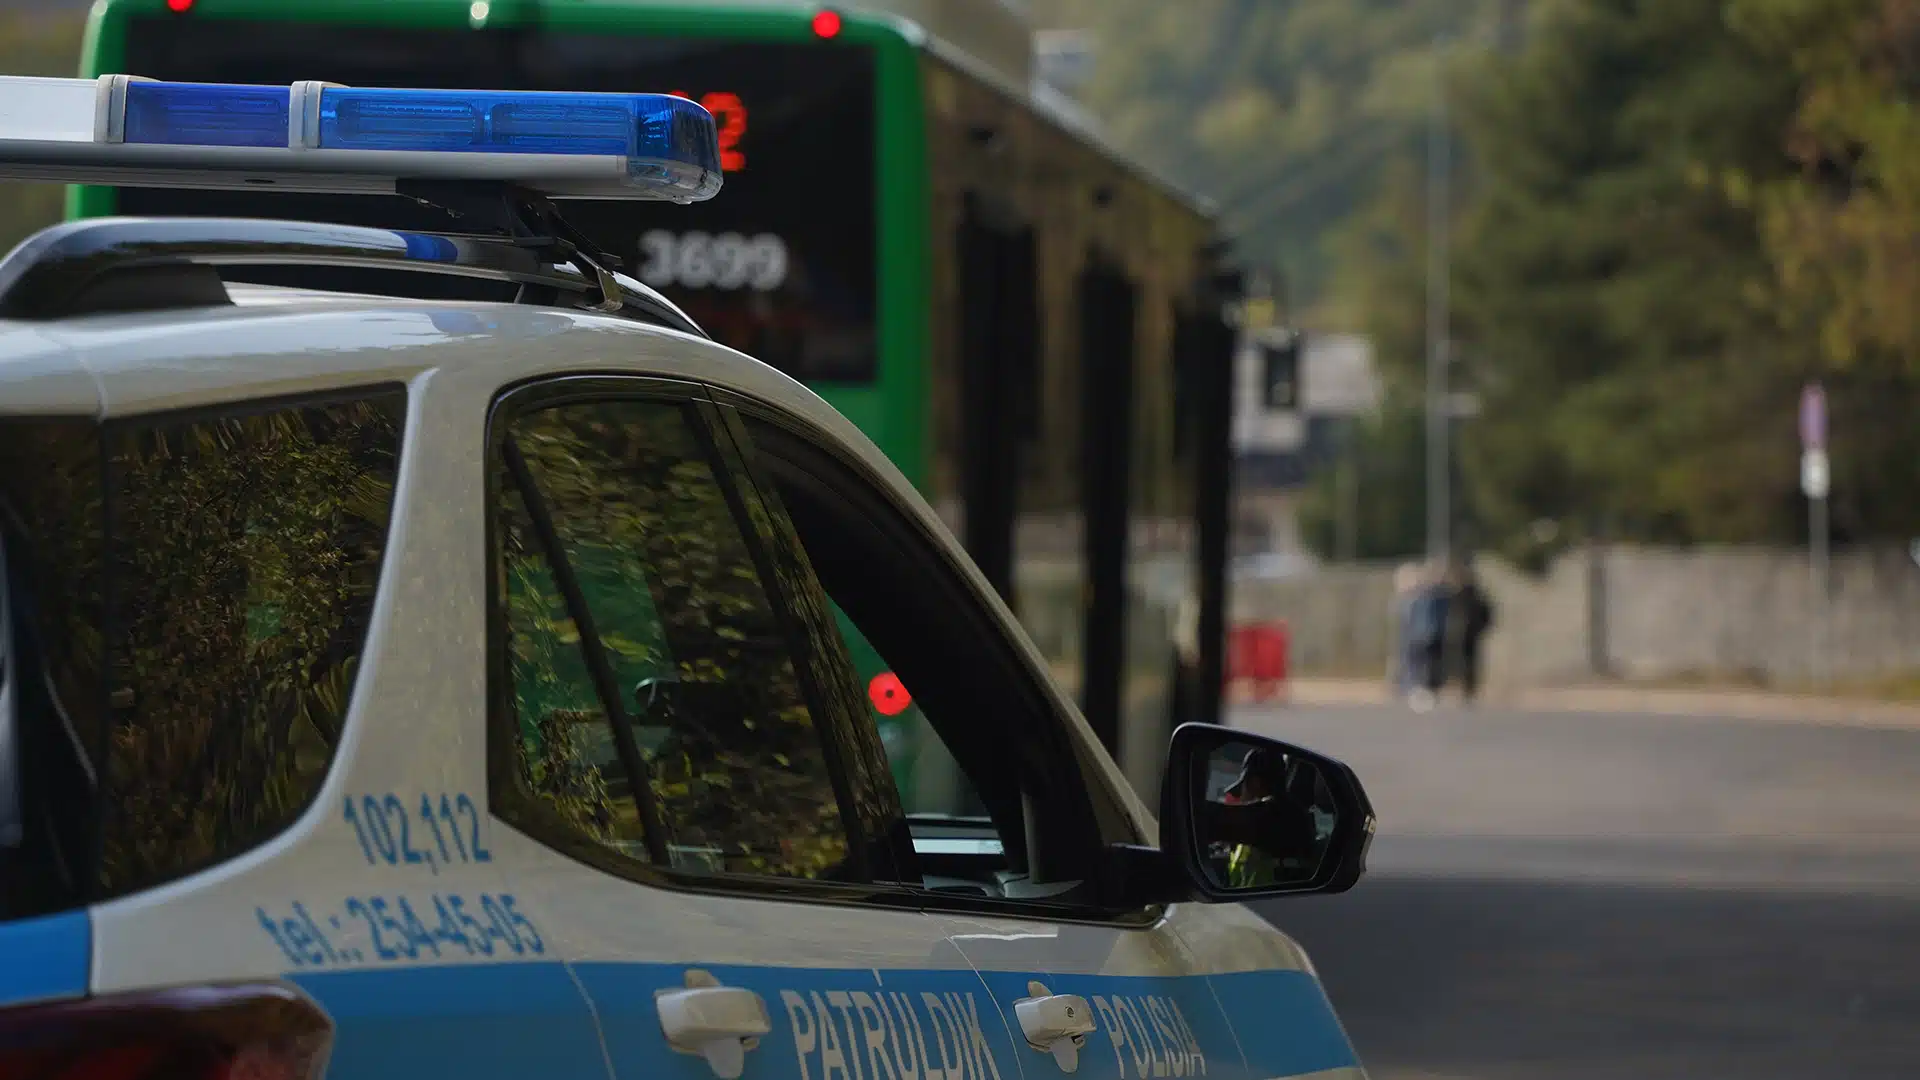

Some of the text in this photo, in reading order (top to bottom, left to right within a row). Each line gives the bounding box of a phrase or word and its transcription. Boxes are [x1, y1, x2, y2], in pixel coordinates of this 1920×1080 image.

[638, 228, 787, 292] 3699
[343, 792, 492, 876] 102,112
[345, 892, 545, 960] 254-45-05
[1091, 994, 1206, 1079] POLISIA
